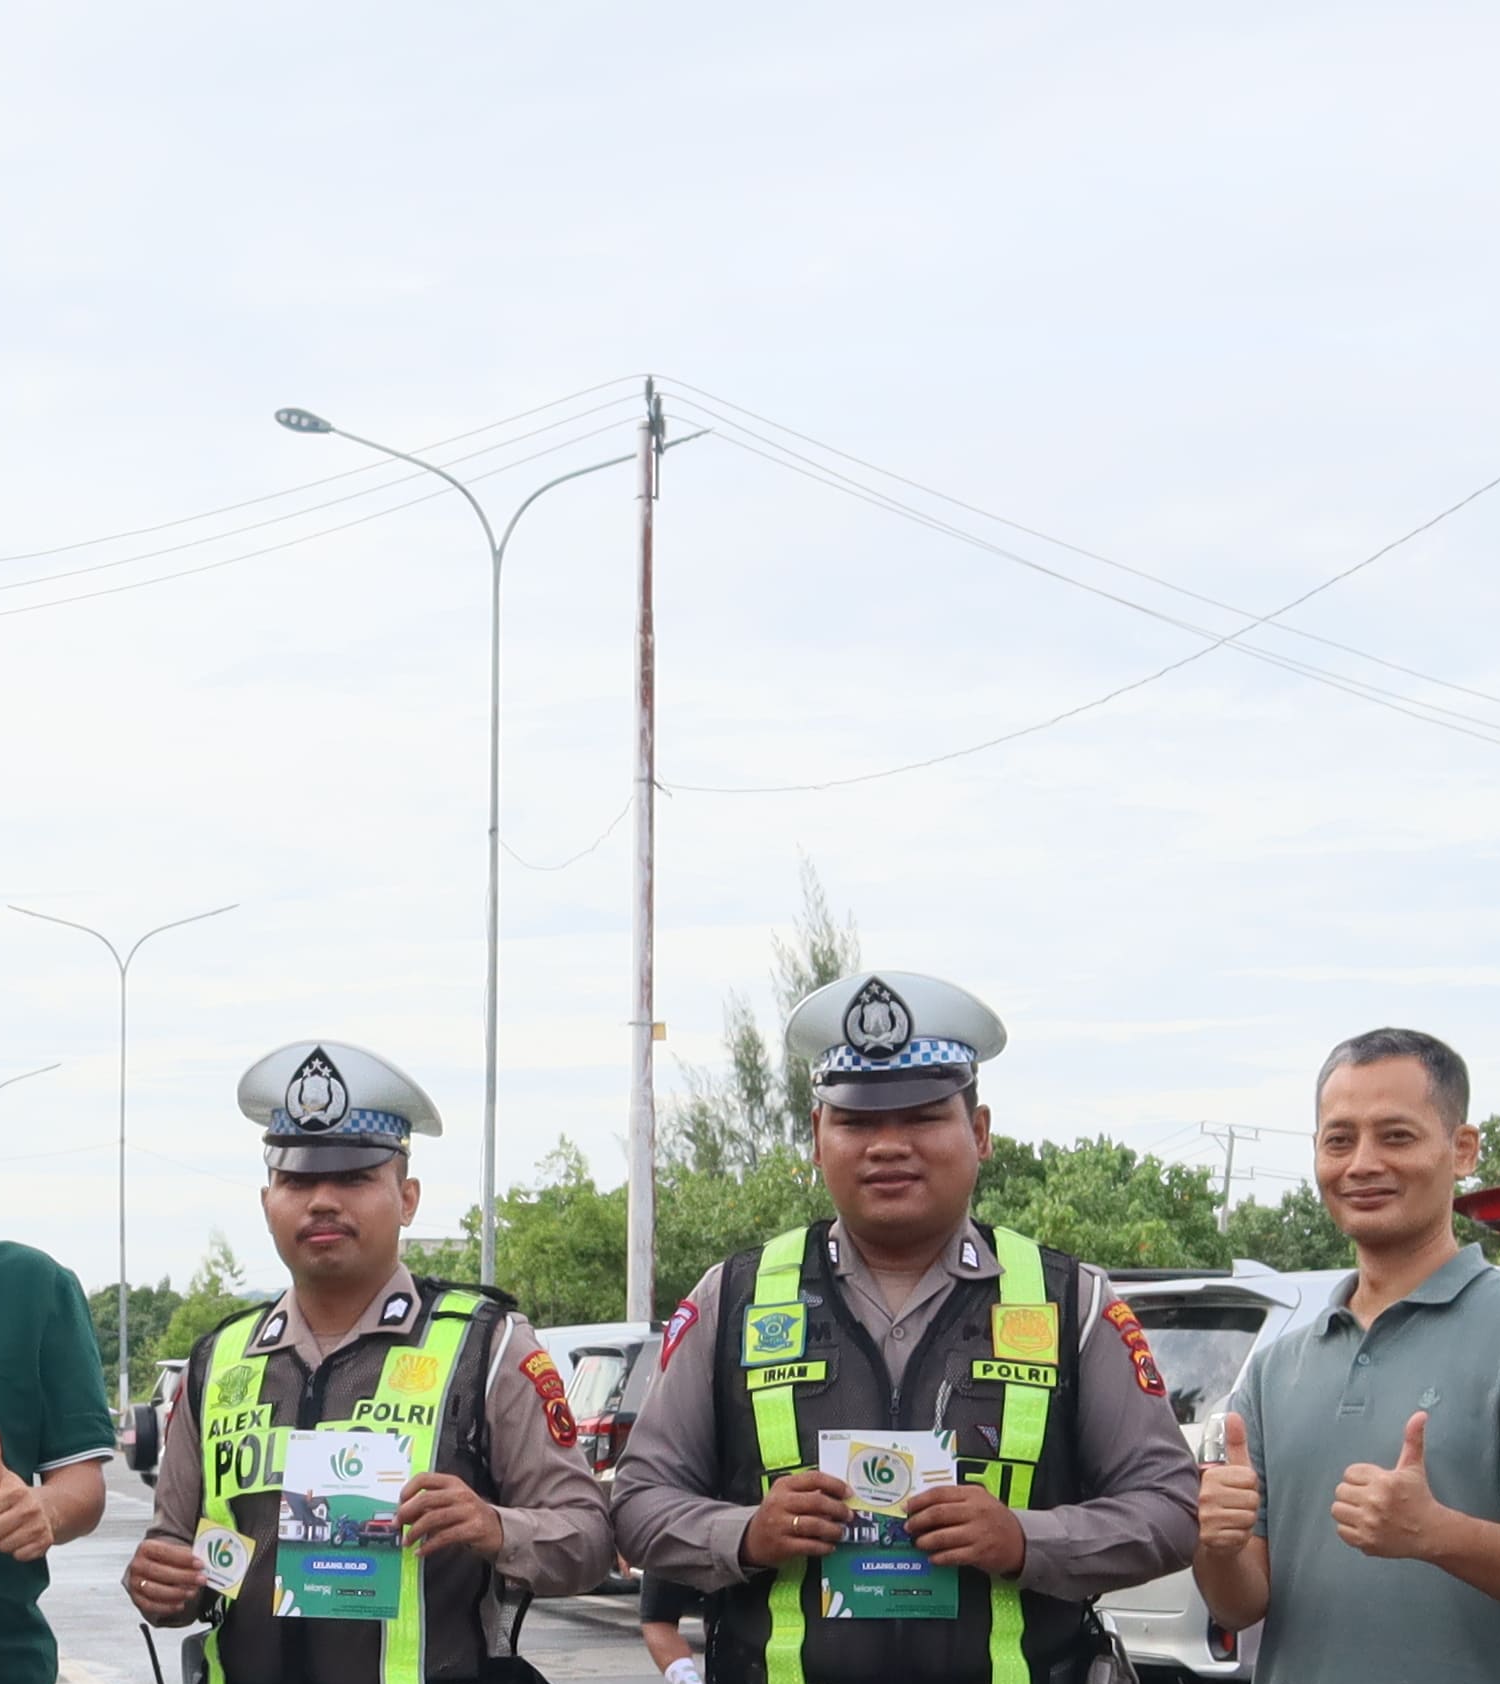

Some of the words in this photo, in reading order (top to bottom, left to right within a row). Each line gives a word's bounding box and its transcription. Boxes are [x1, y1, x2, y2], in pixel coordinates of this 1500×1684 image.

[763, 1364, 808, 1383] IRHAM
[982, 1363, 1049, 1383] POLRI
[208, 1409, 265, 1439] ALEX
[356, 1402, 435, 1426] POLRI
